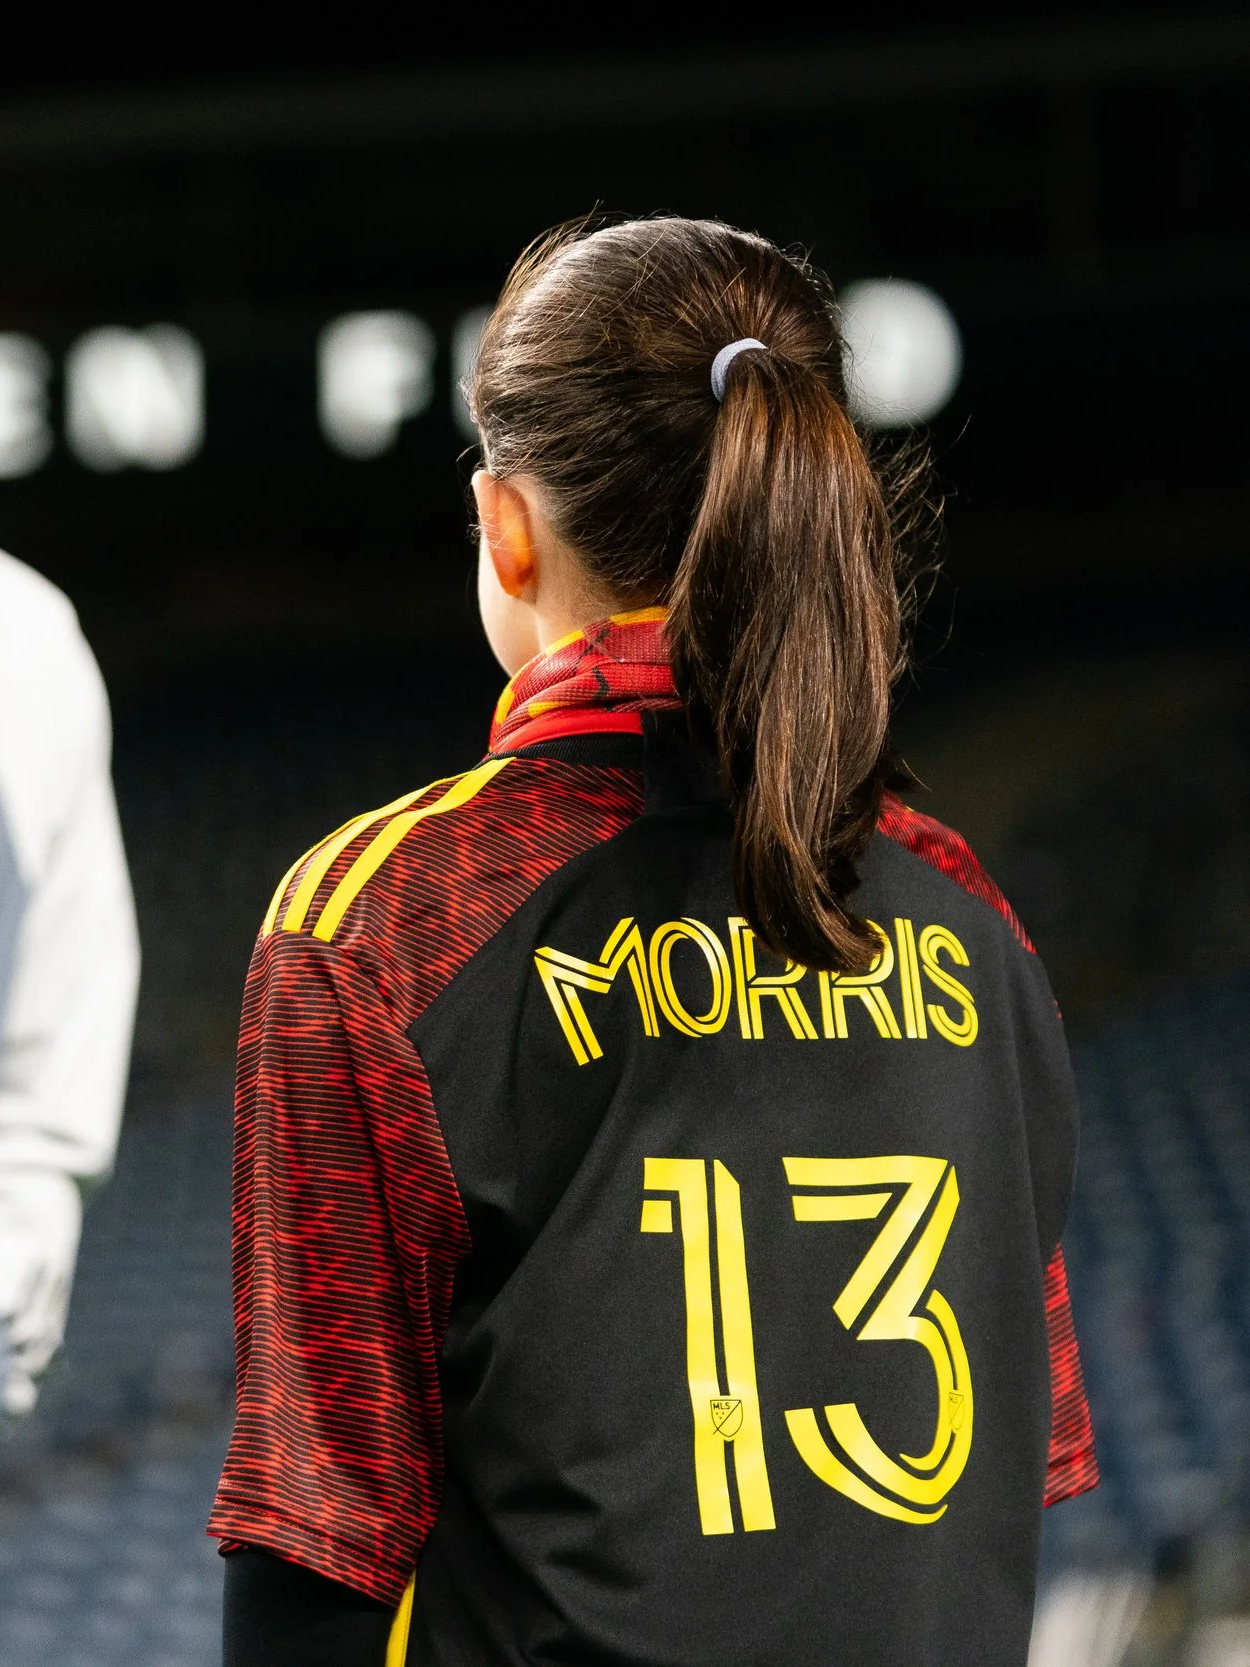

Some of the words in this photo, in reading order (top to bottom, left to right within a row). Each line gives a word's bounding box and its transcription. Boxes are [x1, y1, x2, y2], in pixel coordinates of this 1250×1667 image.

[534, 916, 979, 1066] MORRIS
[640, 1155, 974, 1536] 13
[713, 1402, 731, 1411] MLS
